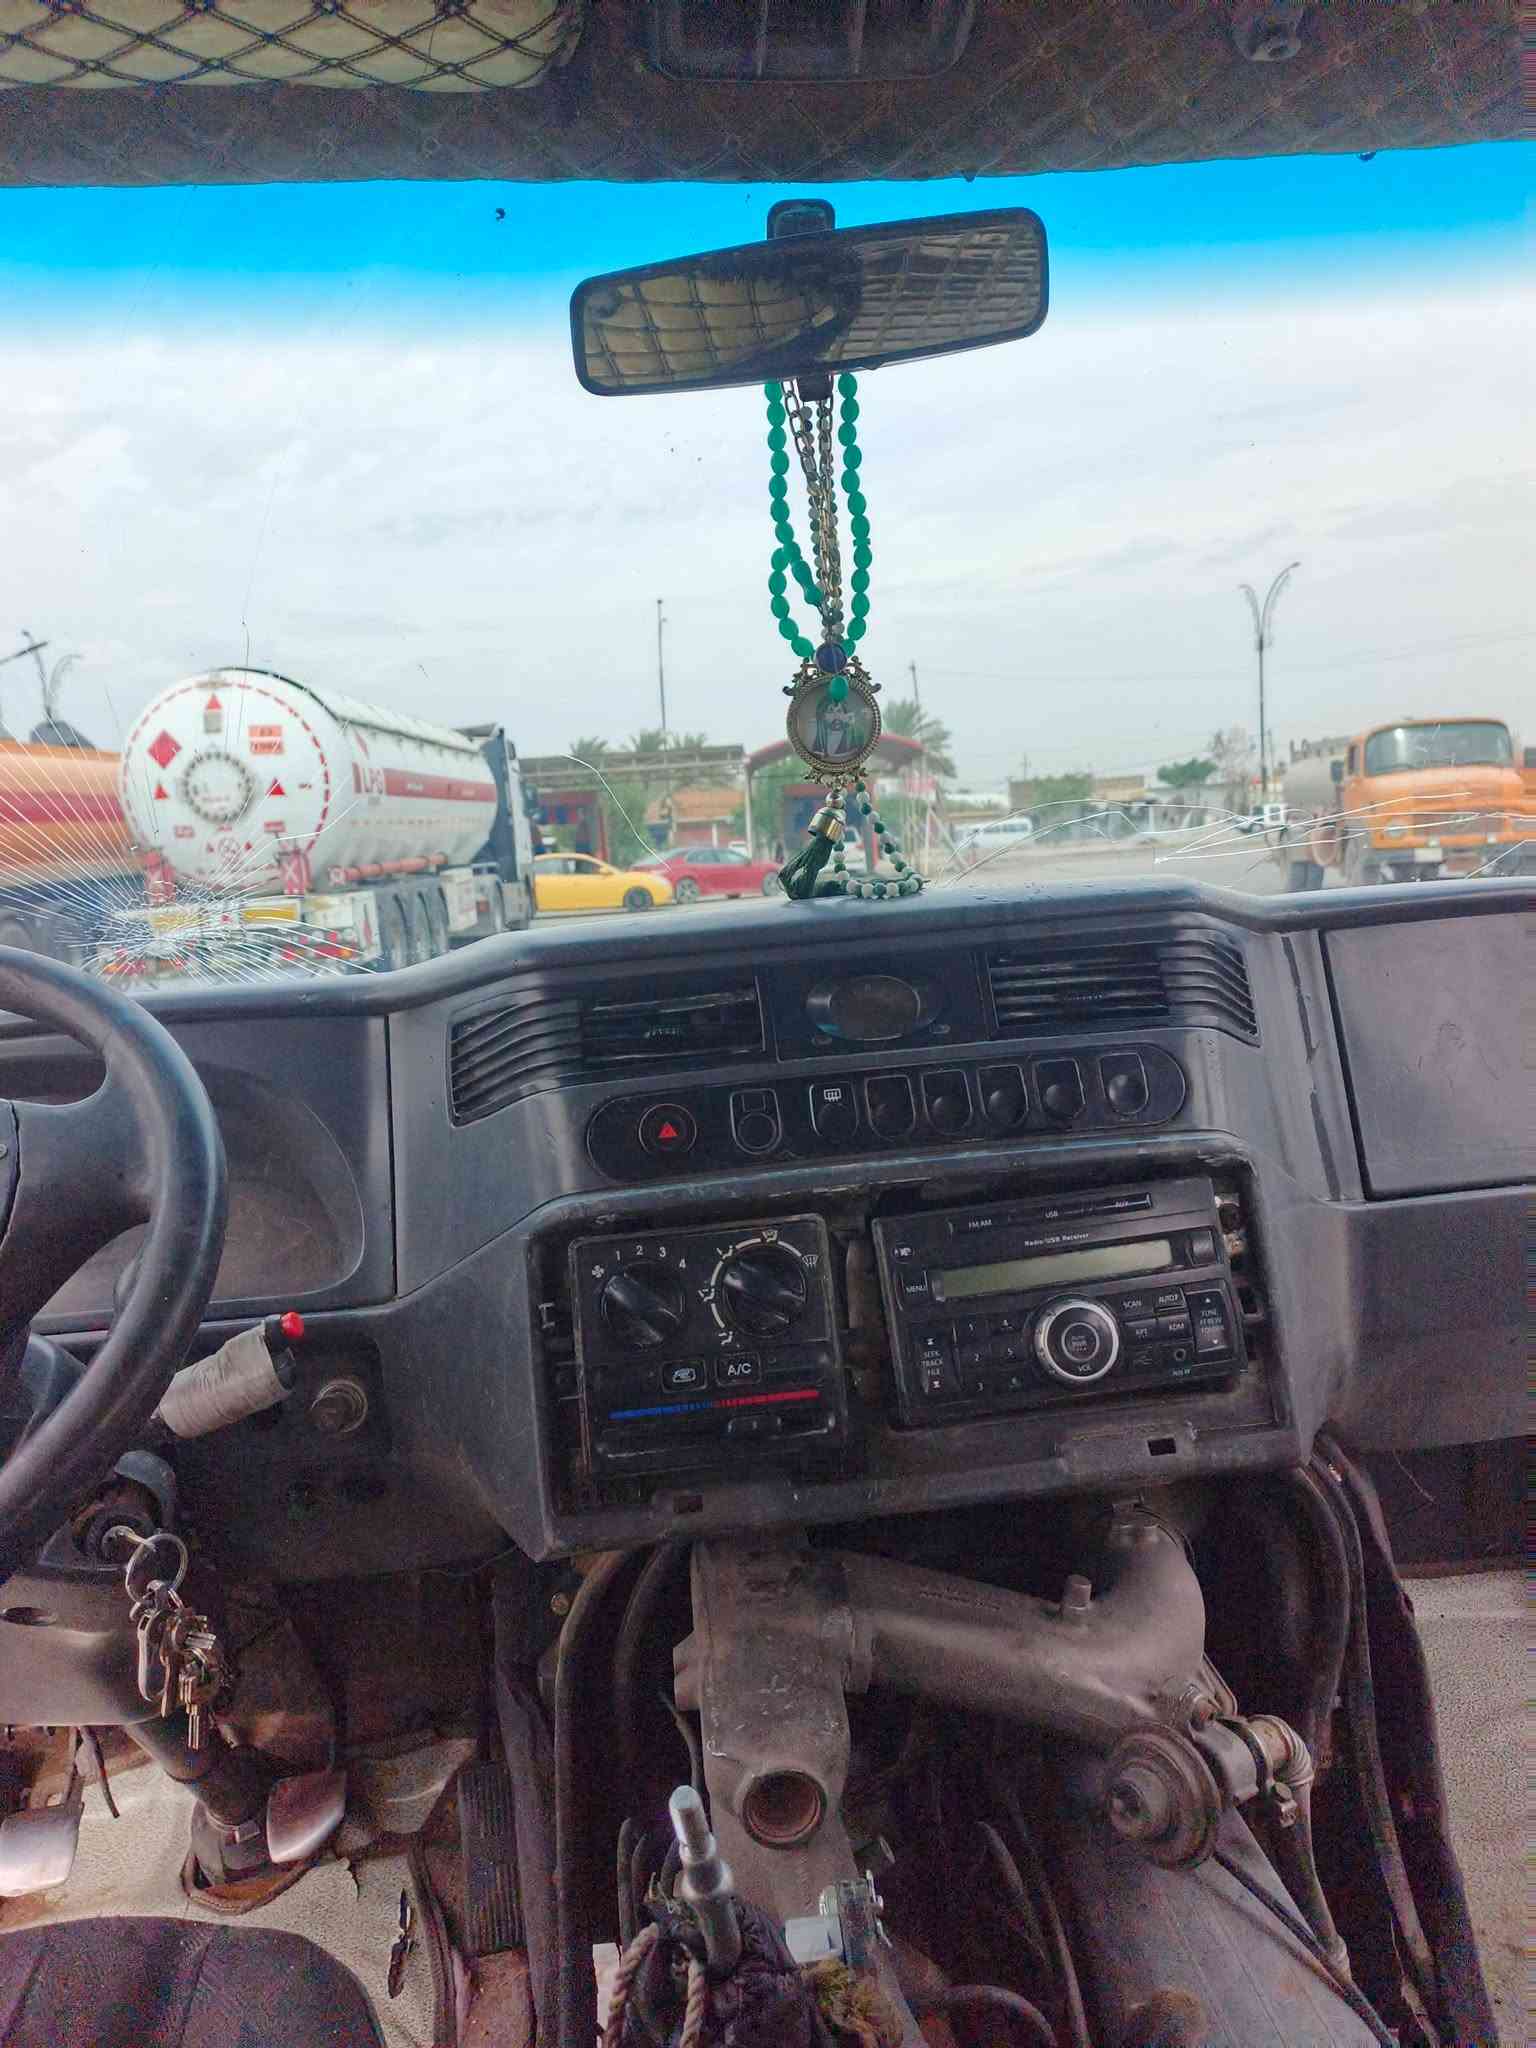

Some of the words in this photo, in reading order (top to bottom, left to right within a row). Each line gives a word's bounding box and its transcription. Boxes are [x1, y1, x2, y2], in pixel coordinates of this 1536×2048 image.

[616, 1250, 621, 1261] 1
[636, 1245, 643, 1256] 2
[659, 1246, 666, 1258] 3
[679, 1258, 686, 1269] 4
[906, 1284, 928, 1294] MENU
[1122, 1300, 1142, 1309] SCAN
[727, 1363, 752, 1376] A/C
[1078, 1364, 1092, 1373] VOL
